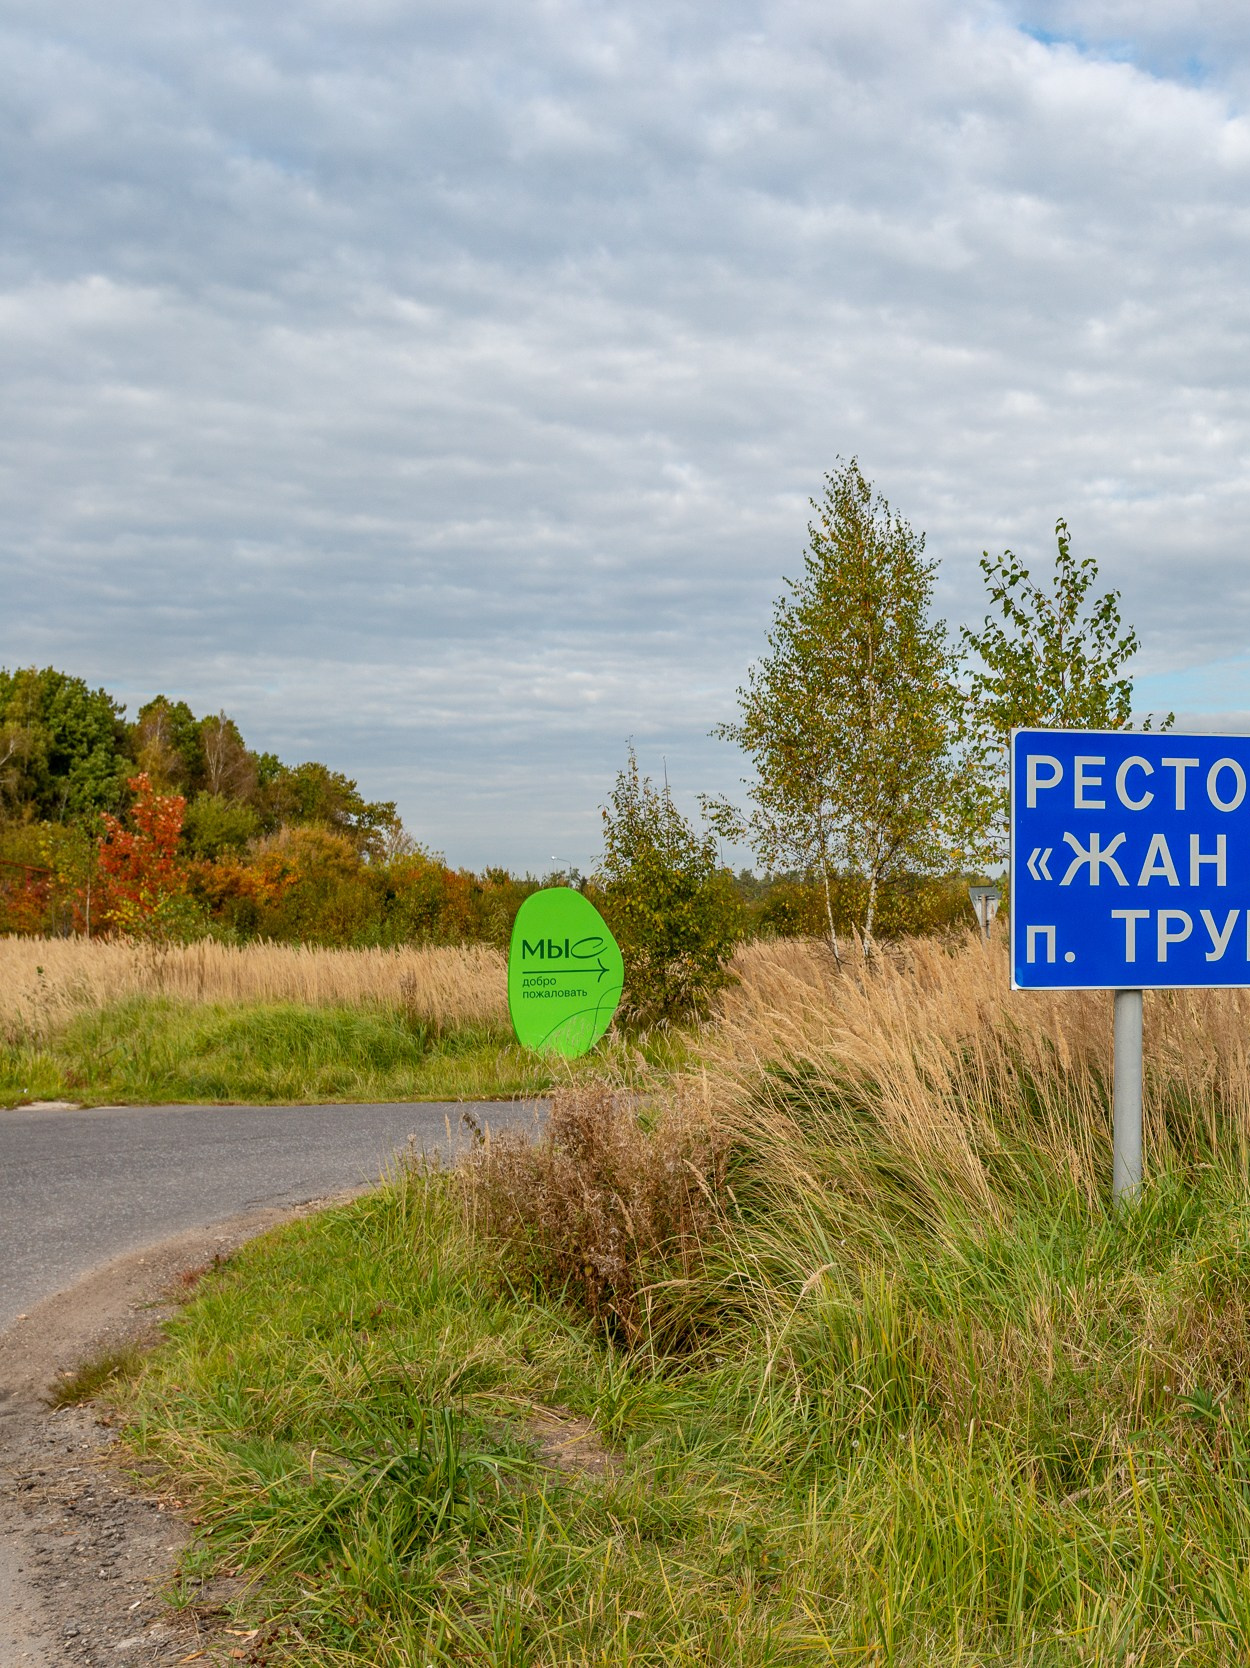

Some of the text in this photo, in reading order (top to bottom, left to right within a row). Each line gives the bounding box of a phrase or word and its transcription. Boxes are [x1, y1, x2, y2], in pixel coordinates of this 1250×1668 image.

[1027, 832, 1227, 887] «ЖАН
[522, 937, 608, 959] МЫС
[1026, 925, 1077, 964] п.
[522, 976, 557, 988] добро
[522, 989, 588, 999] пожаловать
